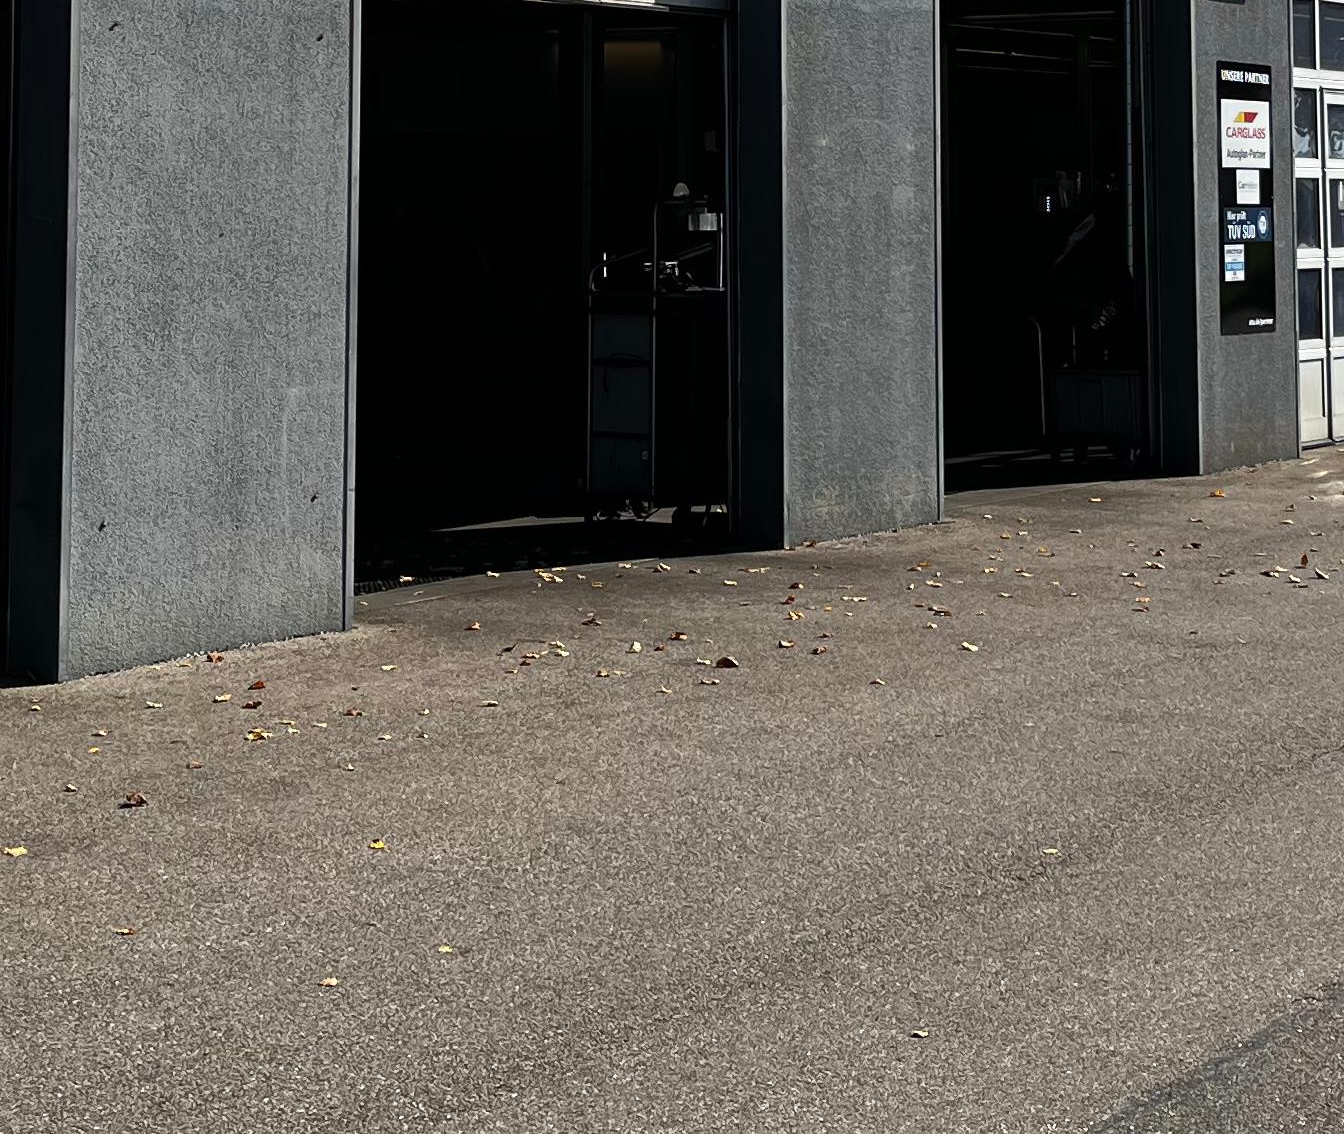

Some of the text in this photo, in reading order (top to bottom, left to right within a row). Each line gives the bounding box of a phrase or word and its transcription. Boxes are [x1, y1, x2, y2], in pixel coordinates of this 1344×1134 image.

[1226, 127, 1266, 139] CARGLASS
[1227, 221, 1241, 240] TÜV
[1242, 221, 1256, 239] SÜD
